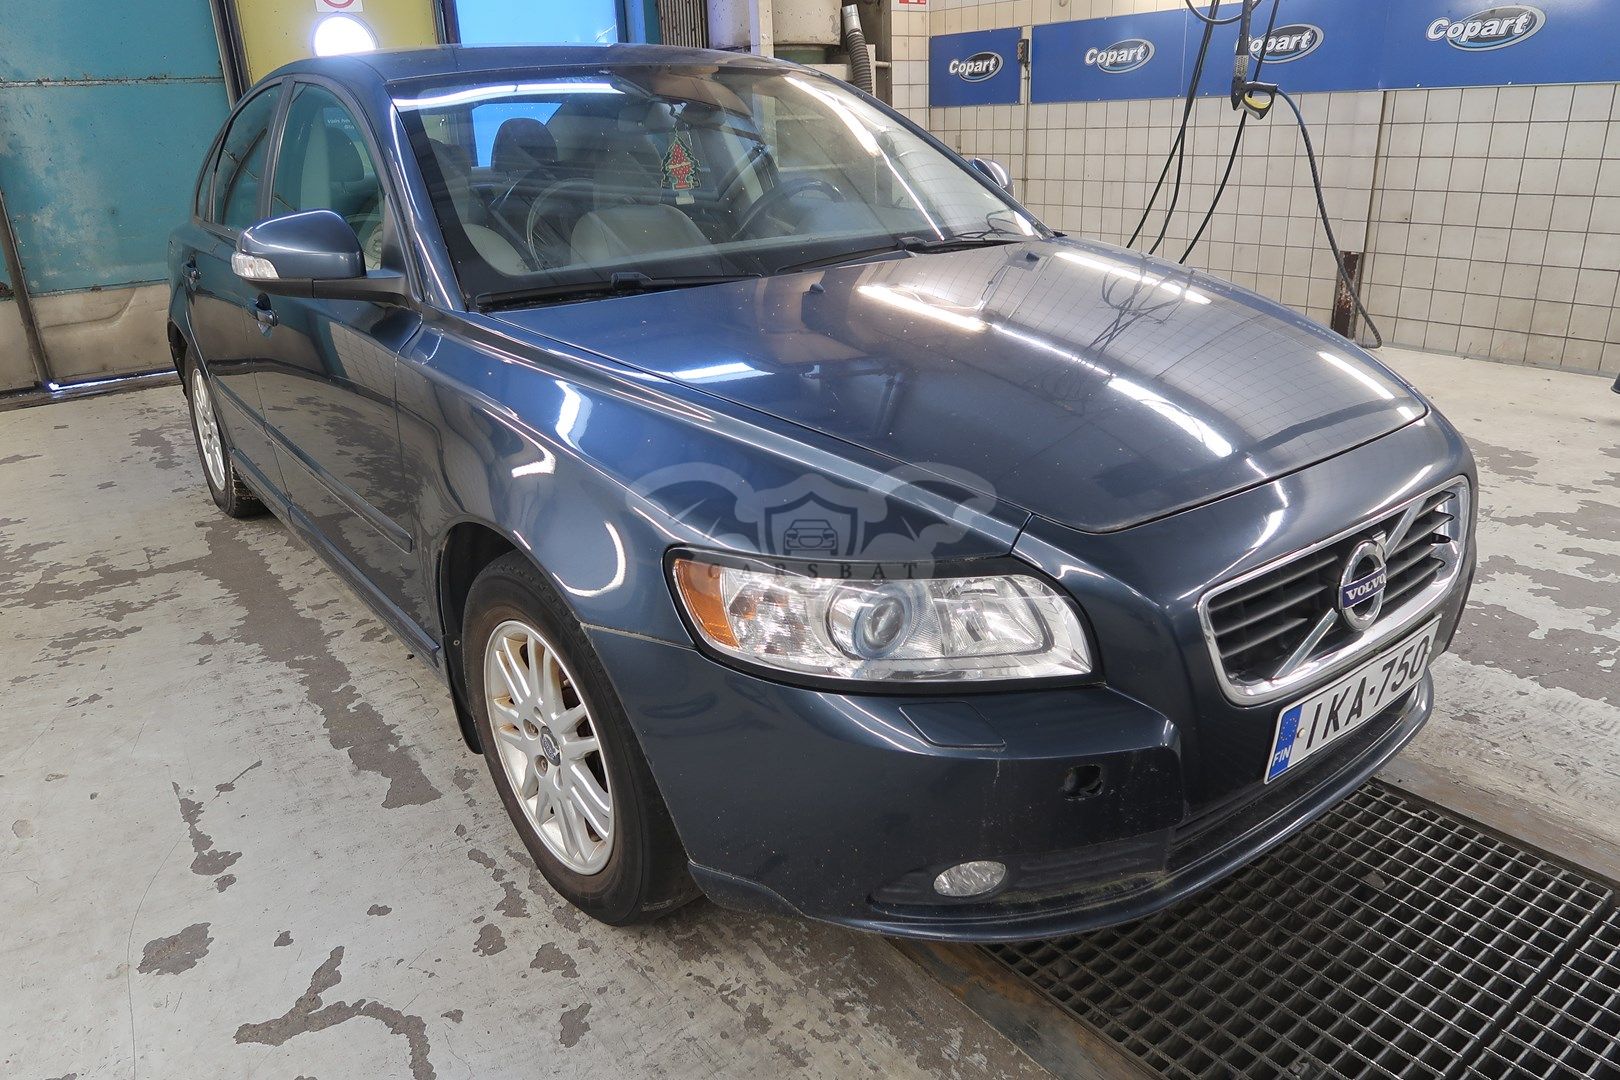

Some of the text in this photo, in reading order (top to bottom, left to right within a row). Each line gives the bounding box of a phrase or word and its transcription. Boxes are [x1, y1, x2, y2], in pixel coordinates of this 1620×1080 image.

[1426, 12, 1529, 42] Copart
[949, 57, 997, 76] Copart
[1085, 44, 1146, 67] Copart
[1345, 573, 1387, 600] VOLVO
[1306, 635, 1430, 750] IKA-750
[1272, 744, 1292, 768] FIN
